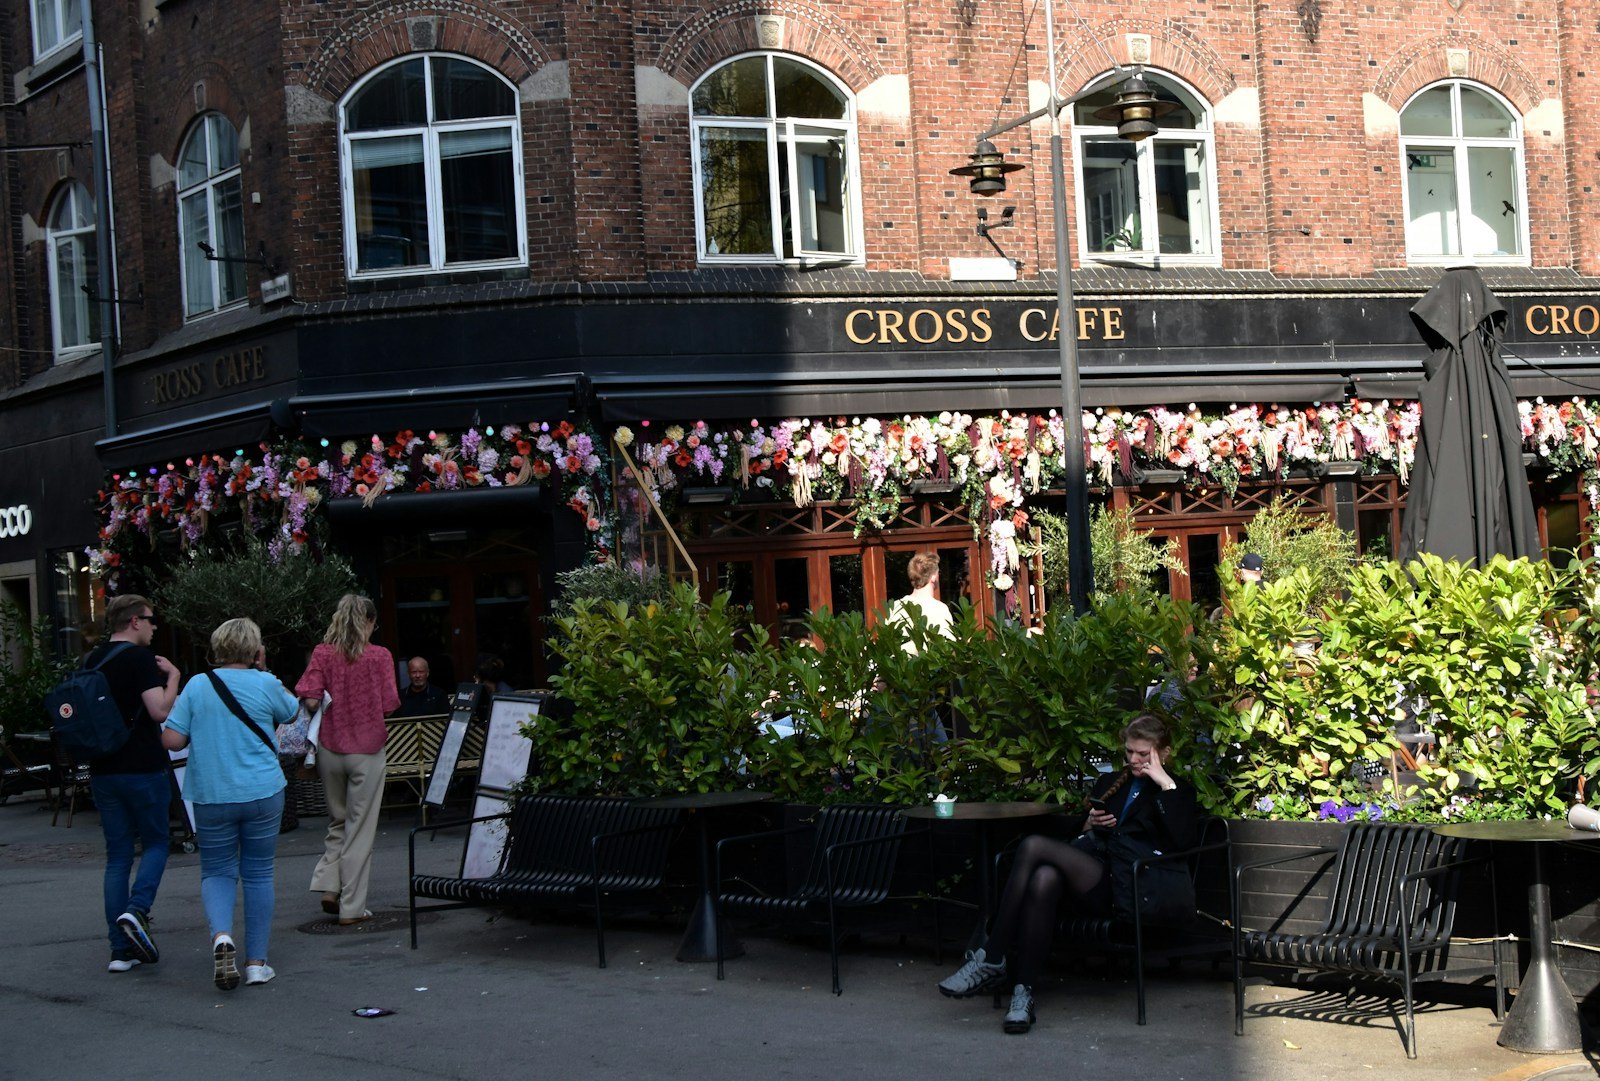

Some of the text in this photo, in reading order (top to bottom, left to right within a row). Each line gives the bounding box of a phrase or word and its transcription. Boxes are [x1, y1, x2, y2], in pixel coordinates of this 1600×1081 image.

[844, 308, 993, 344] CROSS
[1525, 304, 1600, 335] CRO
[152, 345, 265, 404] ROSS CAFE
